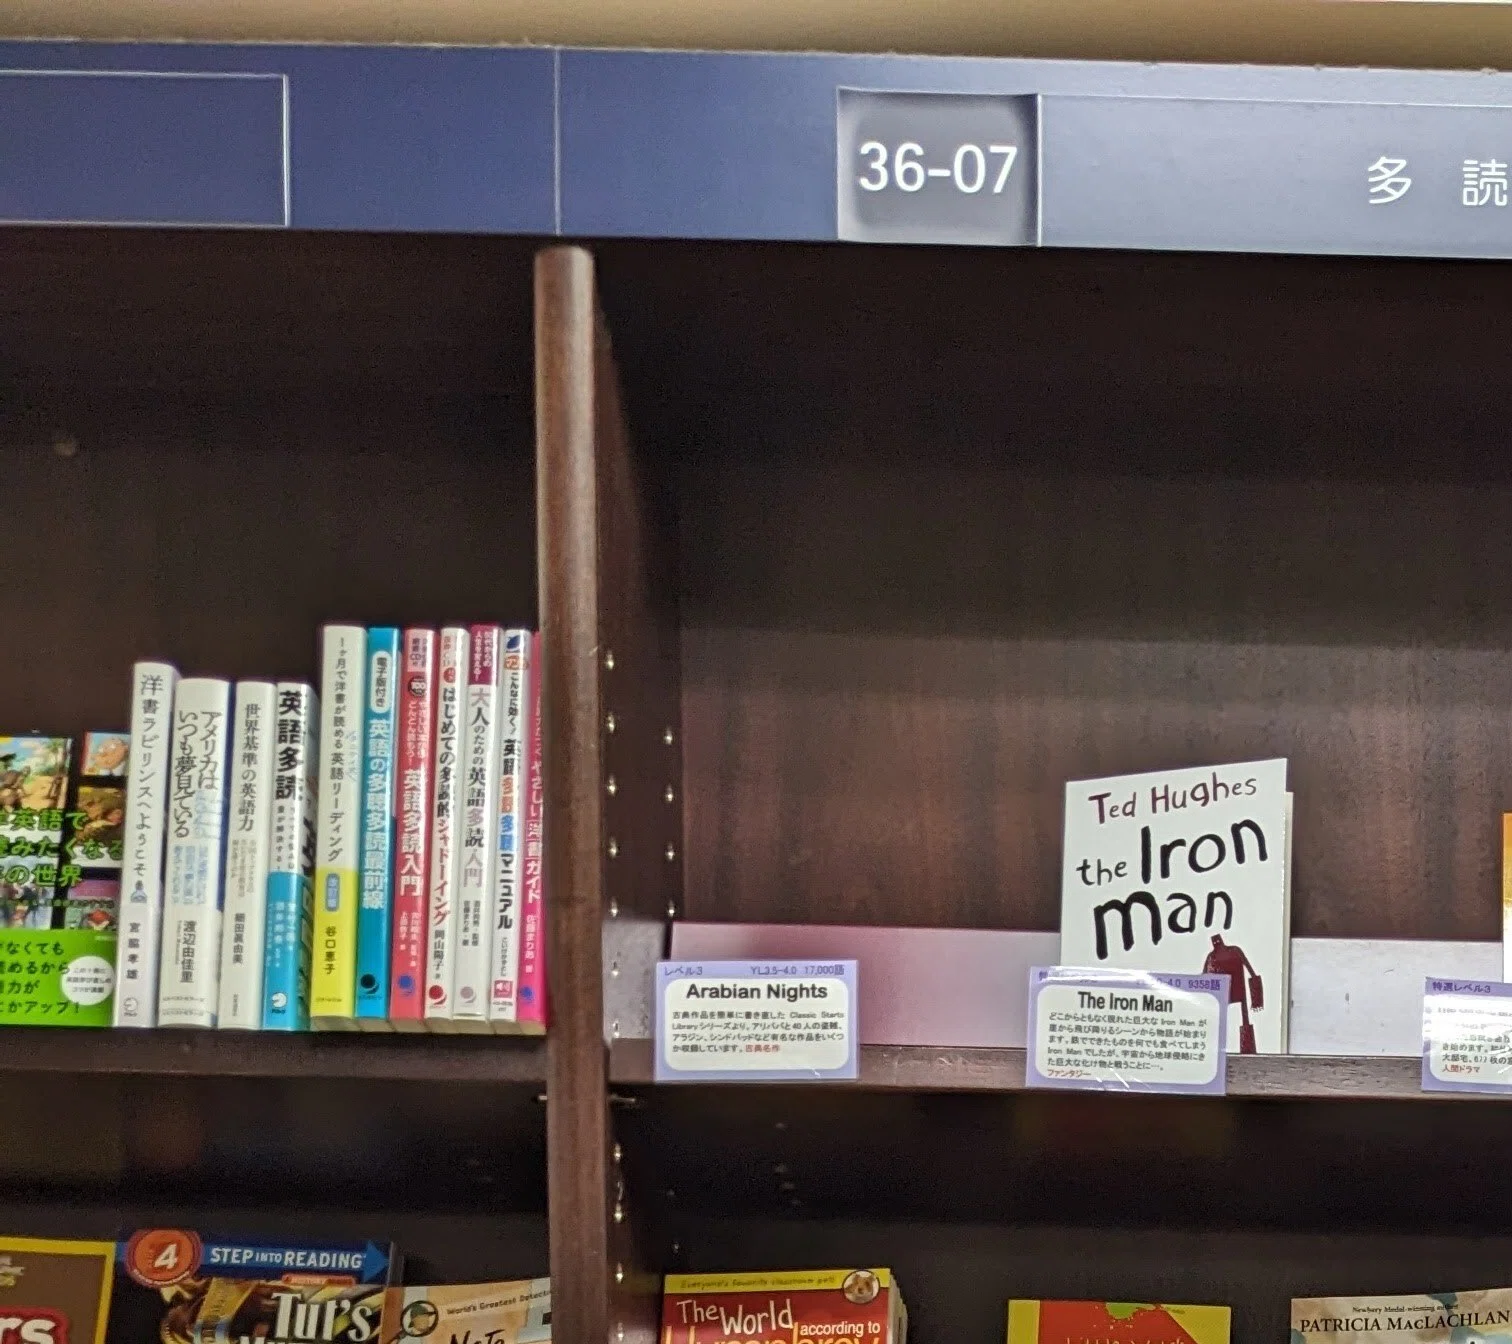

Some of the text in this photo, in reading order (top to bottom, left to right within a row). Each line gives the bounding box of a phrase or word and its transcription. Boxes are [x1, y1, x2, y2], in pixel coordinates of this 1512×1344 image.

[859, 142, 1018, 194] 36-07
[237, 703, 260, 832] 世界基準の英語力
[1088, 773, 1258, 824] Ted Hughes
[1076, 817, 1269, 887] the Iron
[686, 983, 828, 1002] Arabian Nights
[210, 1248, 364, 1269] STEP INTO READING
[272, 1292, 374, 1342] Tut's
[800, 1321, 880, 1337] according to
